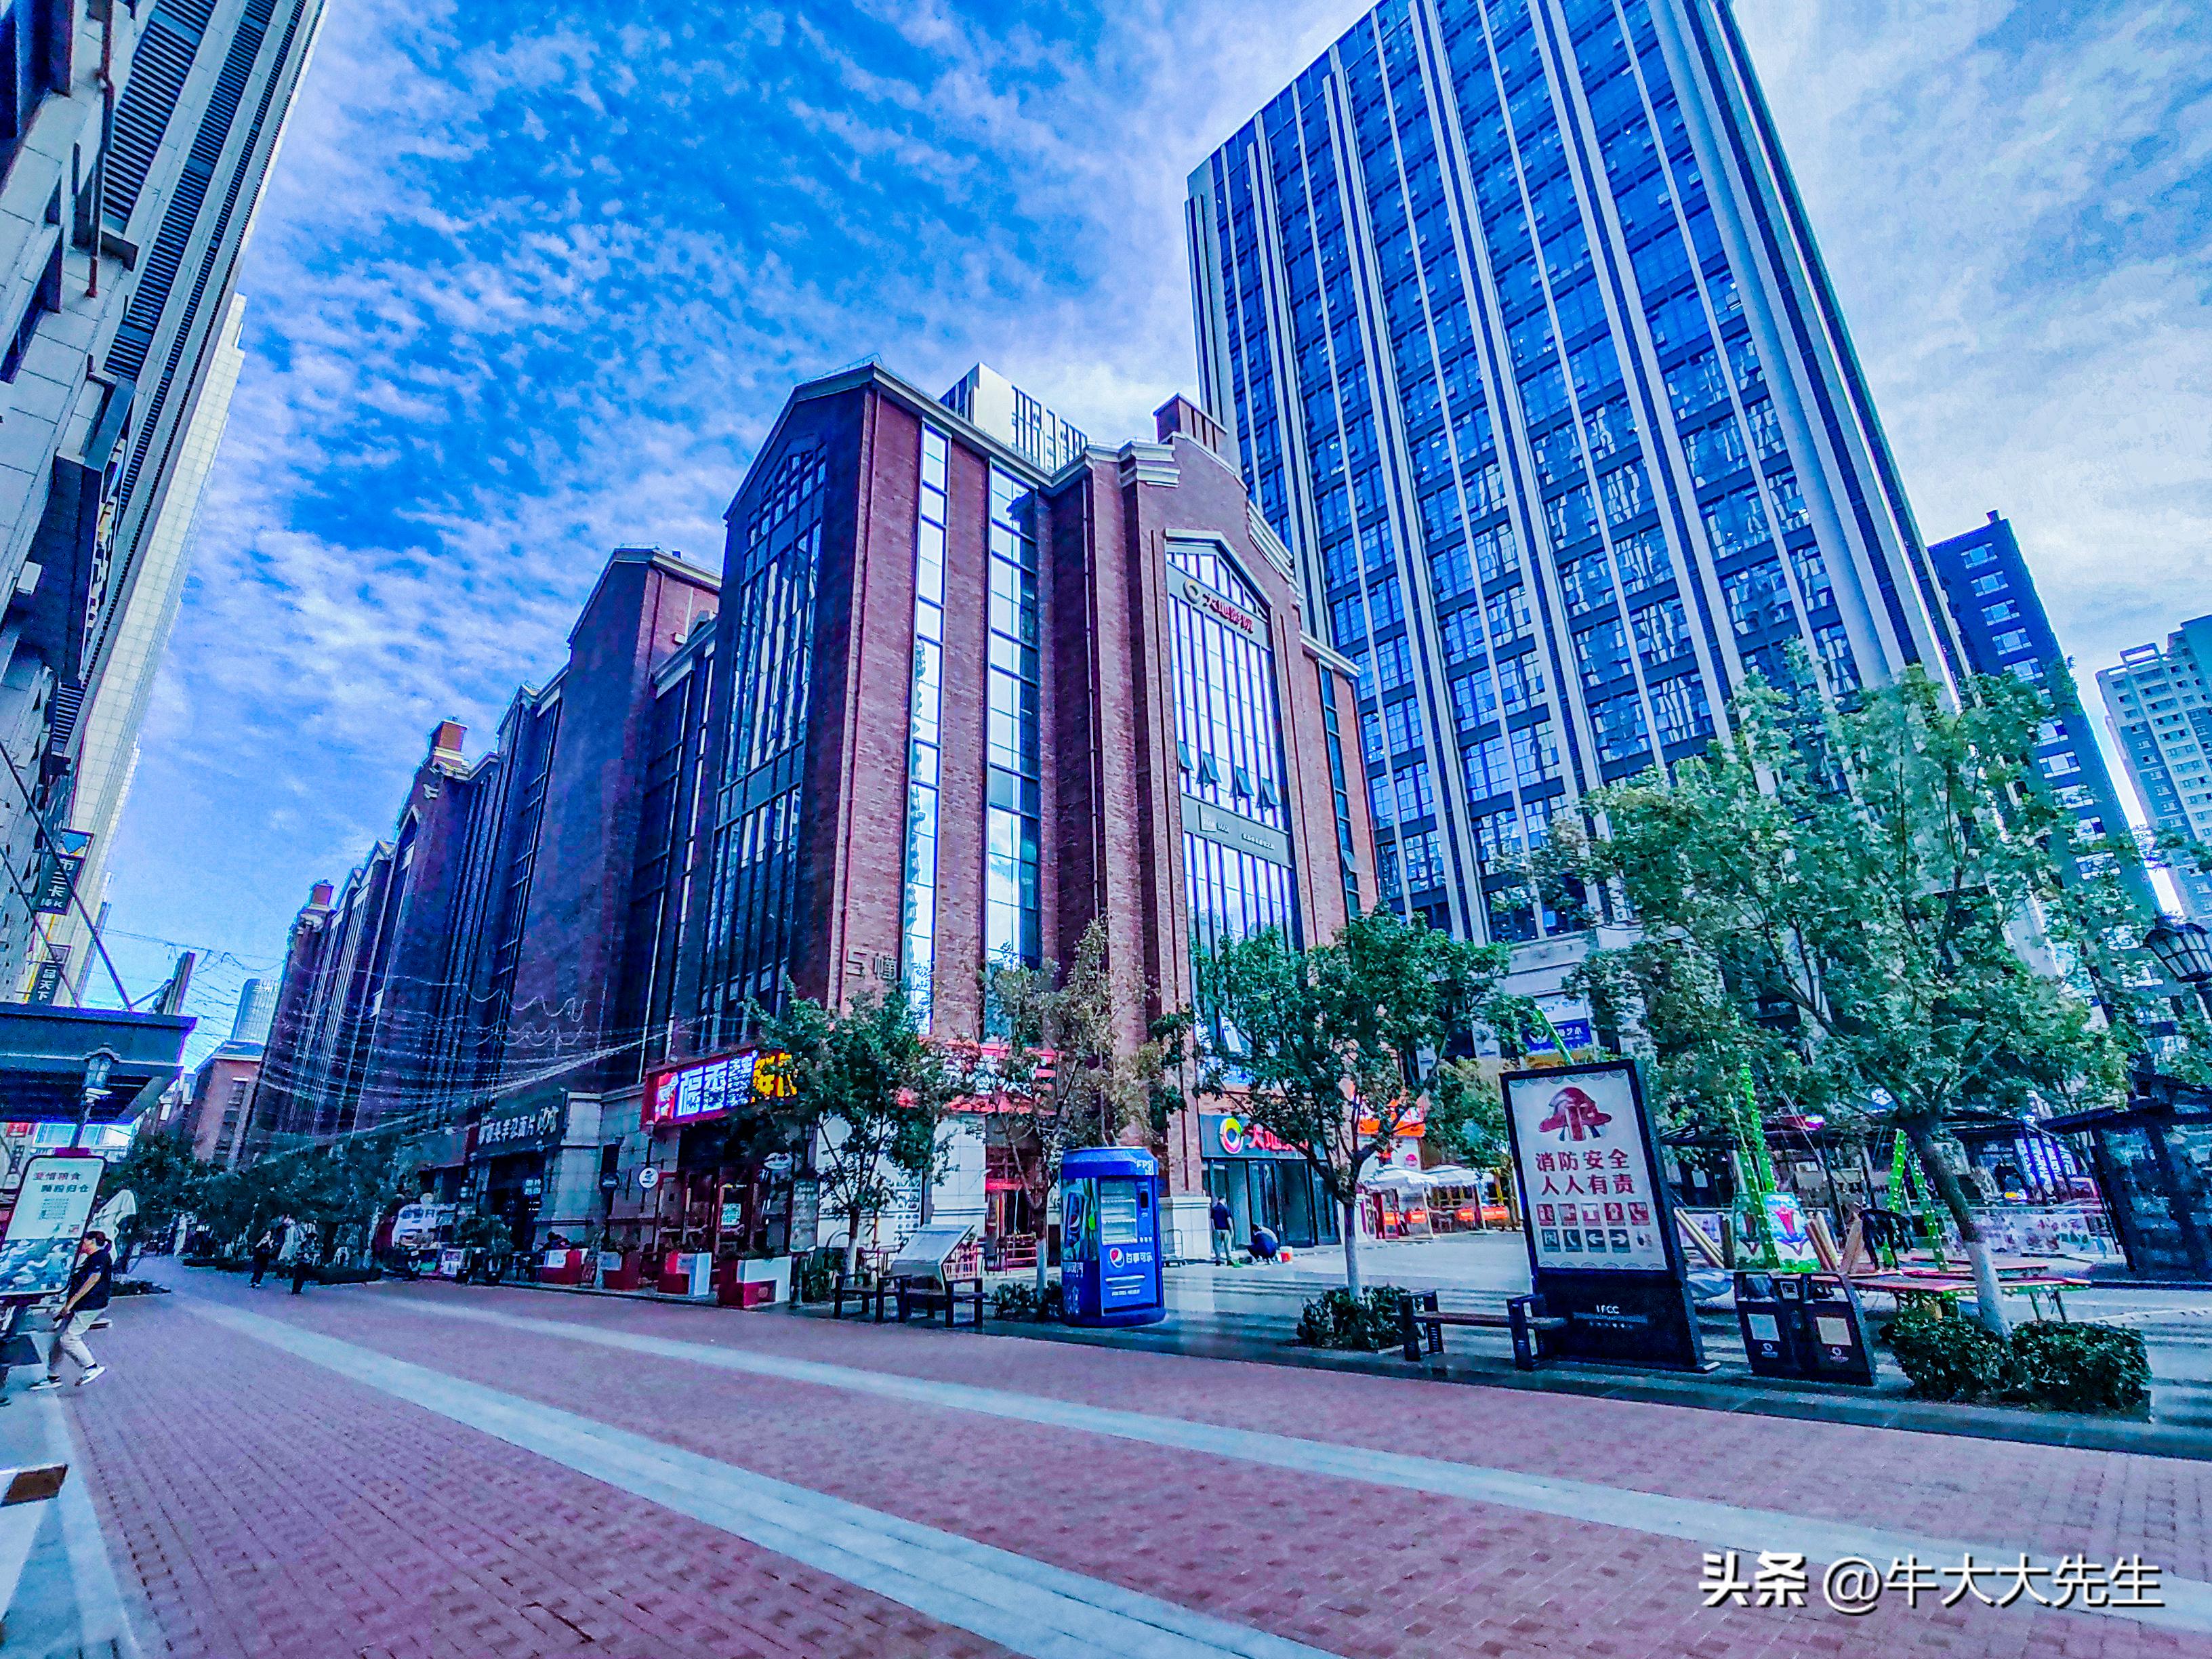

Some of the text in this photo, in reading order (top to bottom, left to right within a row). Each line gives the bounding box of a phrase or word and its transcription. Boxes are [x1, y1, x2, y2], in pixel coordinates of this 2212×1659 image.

[1535, 1148, 1630, 1172] 消防安全
[1541, 1173, 1635, 1196] 人人有责
[1596, 1305, 1620, 1315] IFCC
